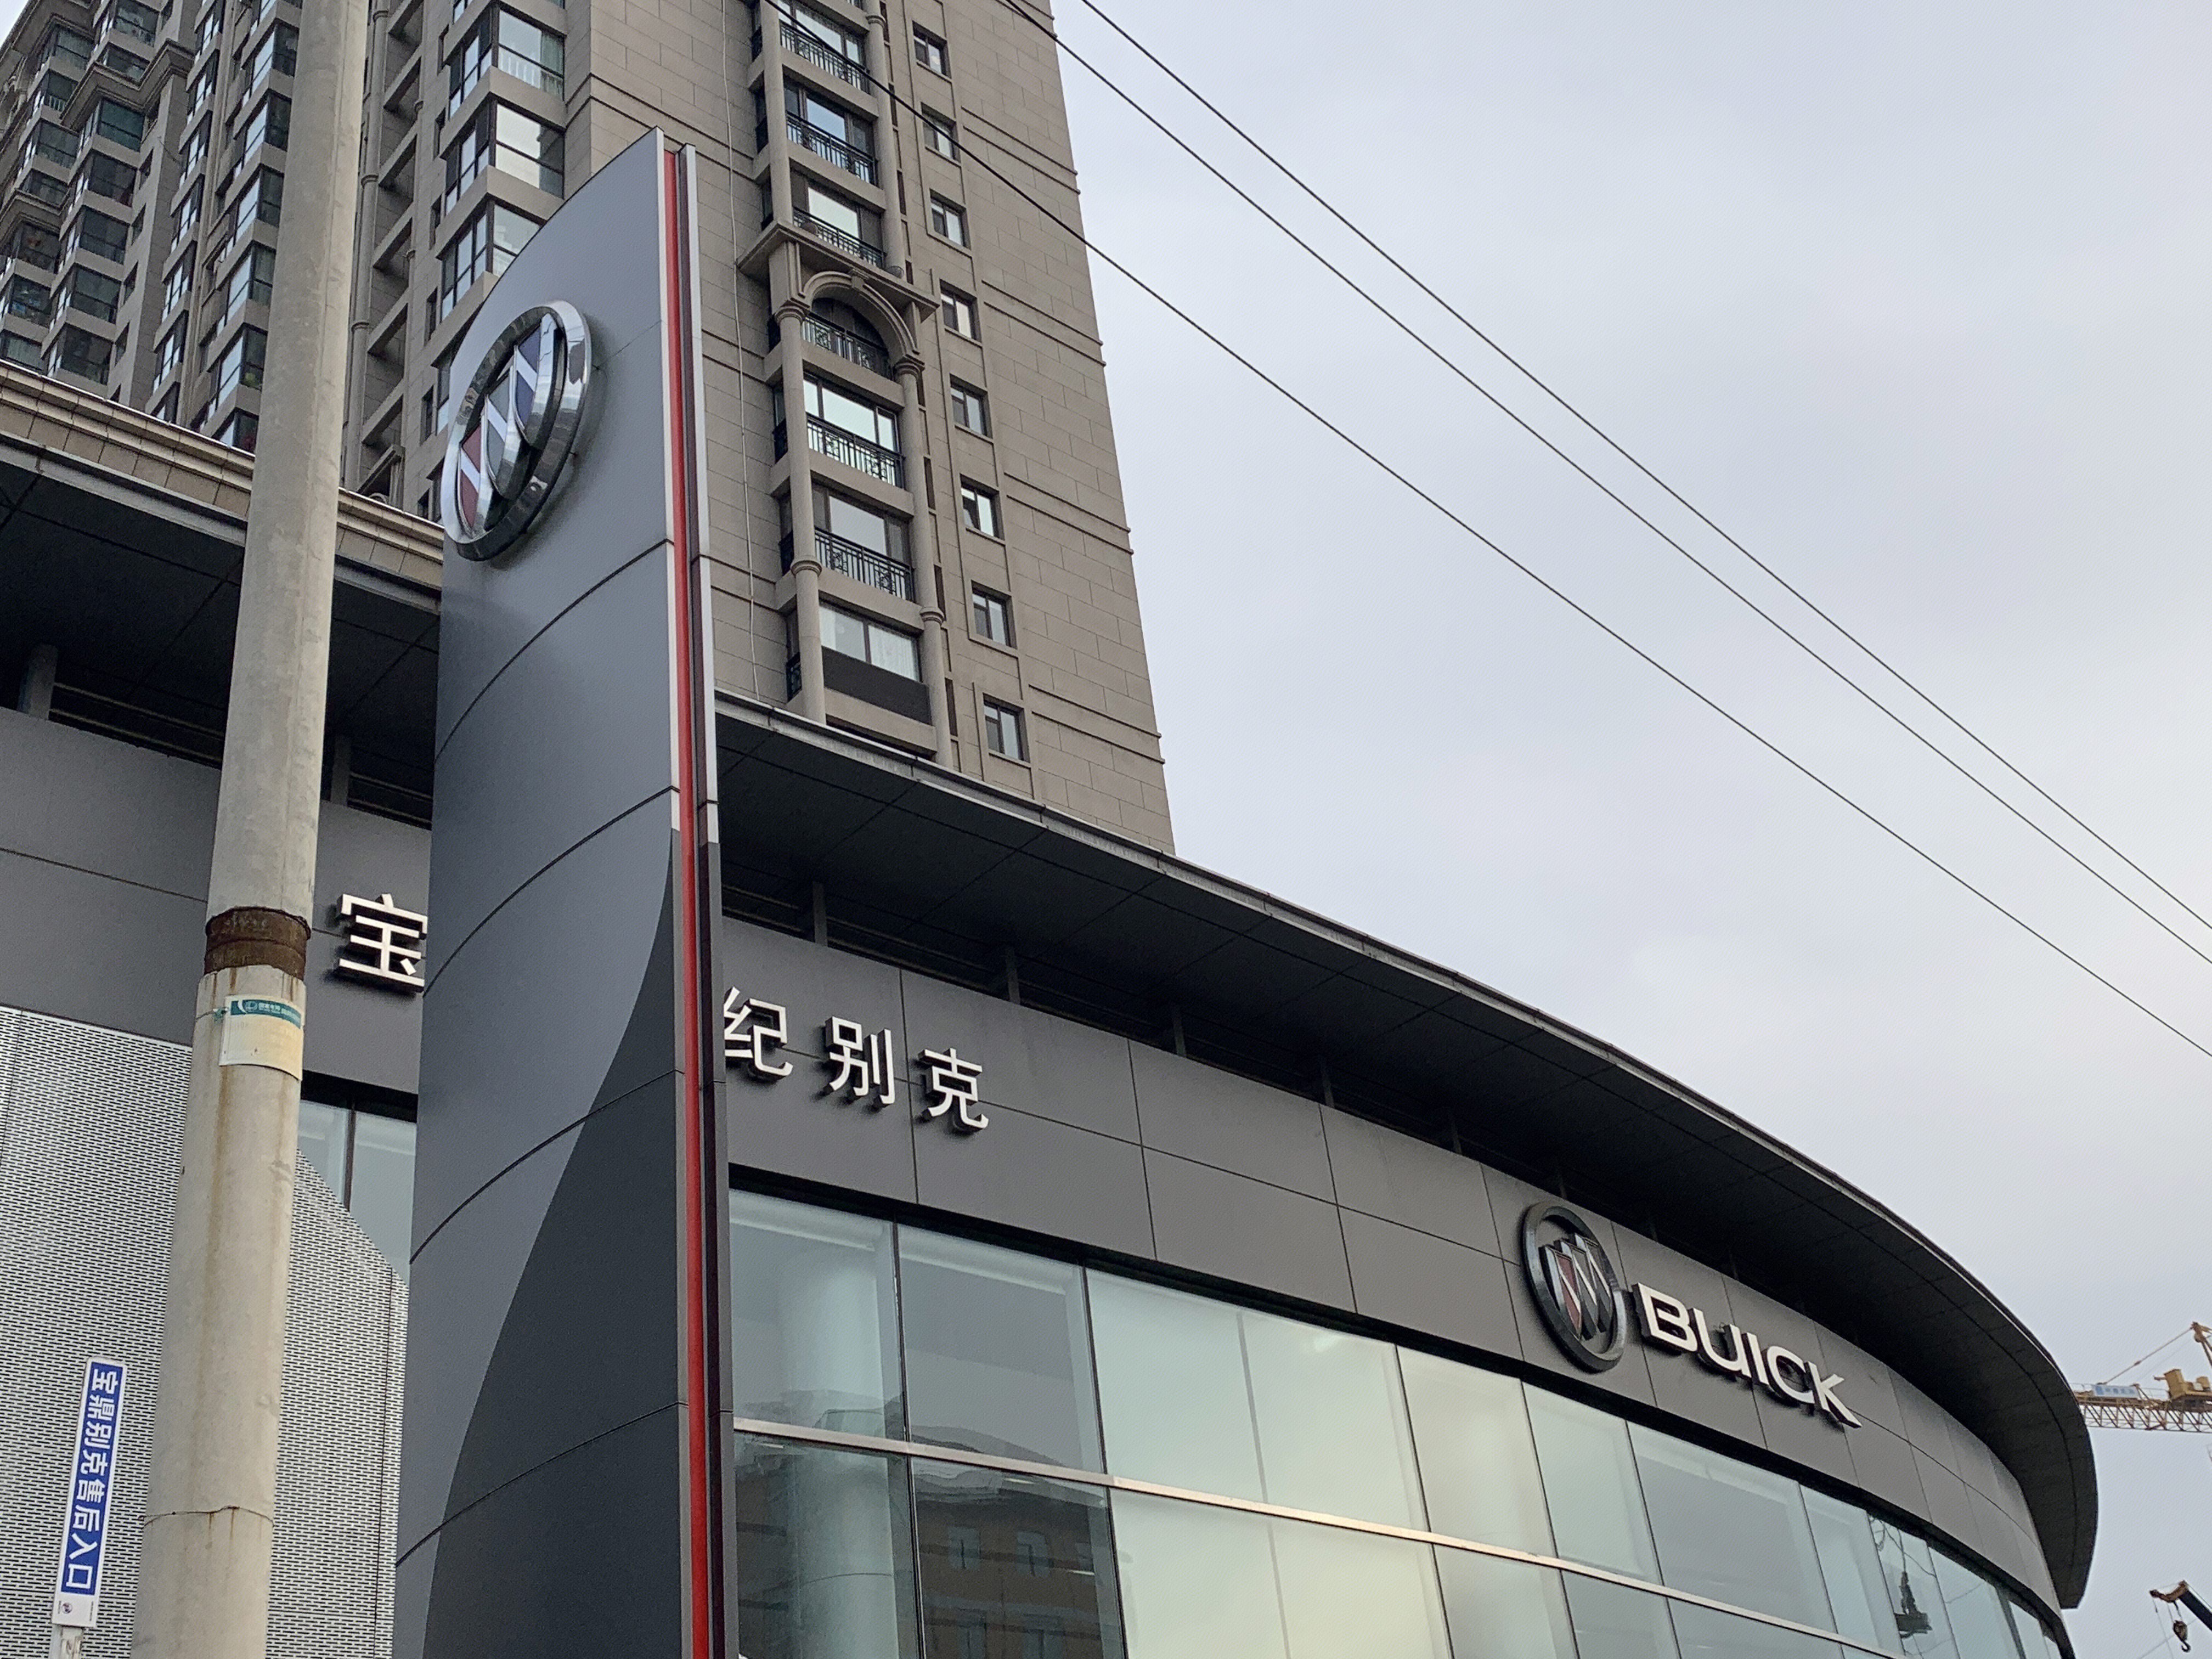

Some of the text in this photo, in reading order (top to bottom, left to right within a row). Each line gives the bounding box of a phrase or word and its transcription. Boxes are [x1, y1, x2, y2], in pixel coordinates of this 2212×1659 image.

[338, 893, 989, 1130] 宝 纪别克
[1637, 1282, 1863, 1429] BUICK
[65, 1368, 119, 1590] 宝鼎别克售后入口
